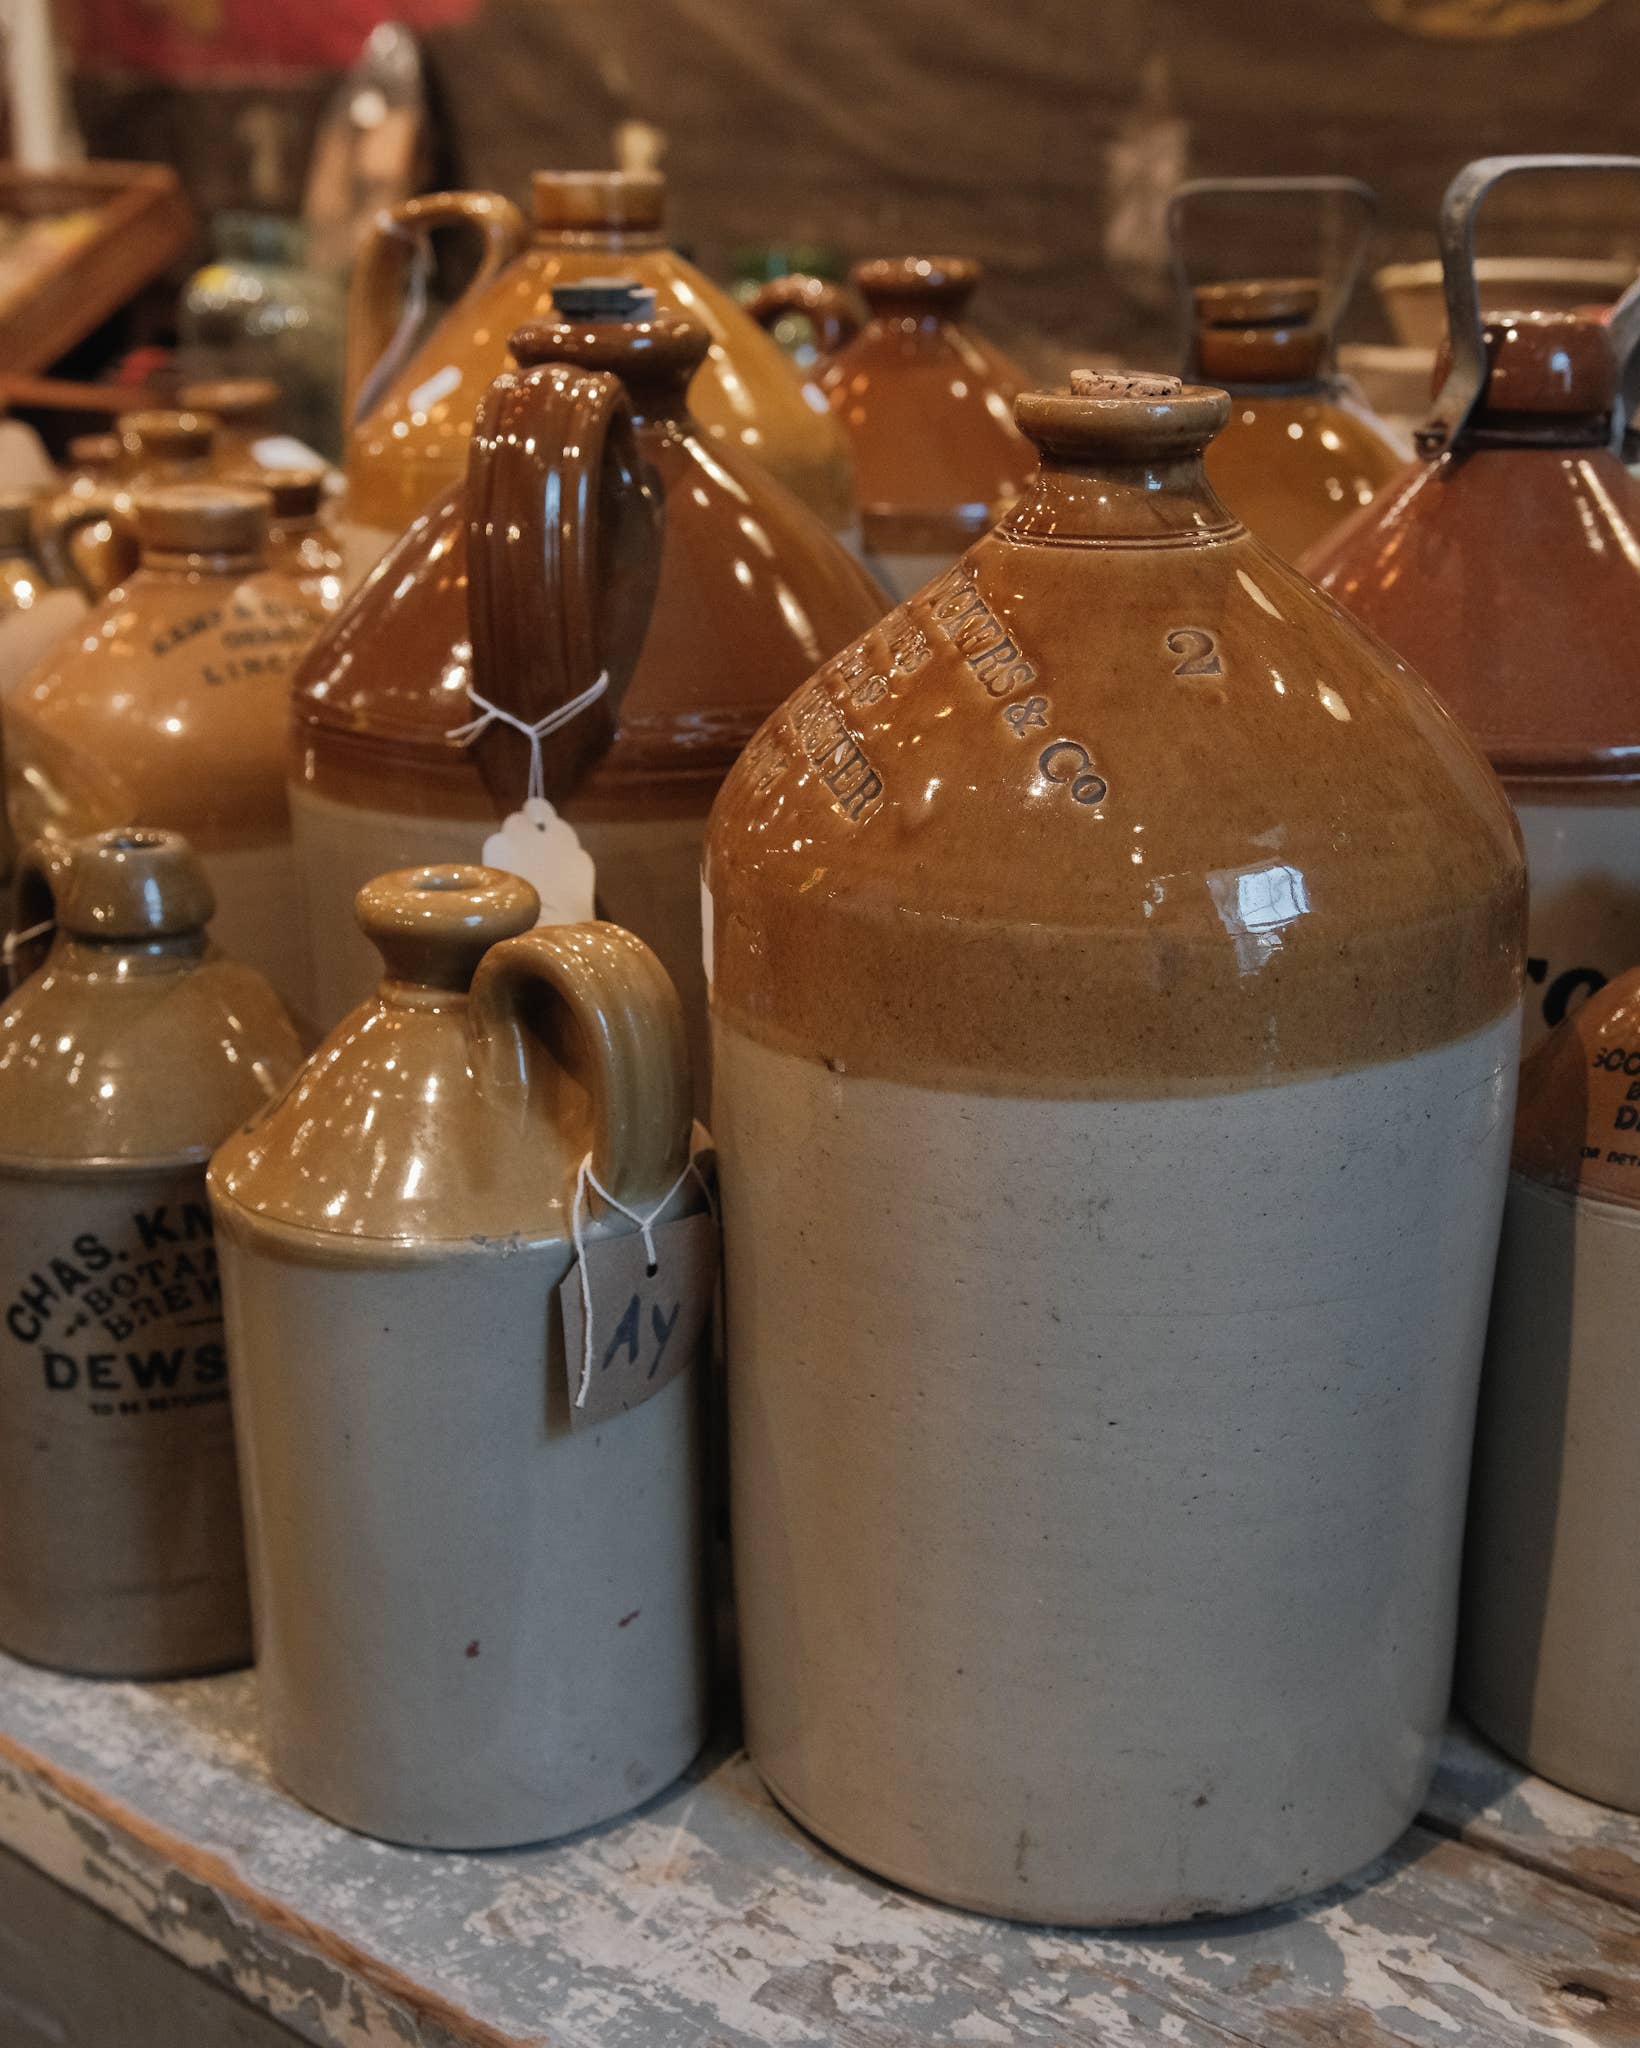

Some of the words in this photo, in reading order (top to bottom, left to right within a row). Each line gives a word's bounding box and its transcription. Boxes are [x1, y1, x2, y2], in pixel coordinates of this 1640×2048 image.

[1167, 629, 1223, 676] 2
[1003, 696, 1050, 738] &
[7, 1232, 129, 1343] CHAS.
[43, 1344, 229, 1391] DEWS
